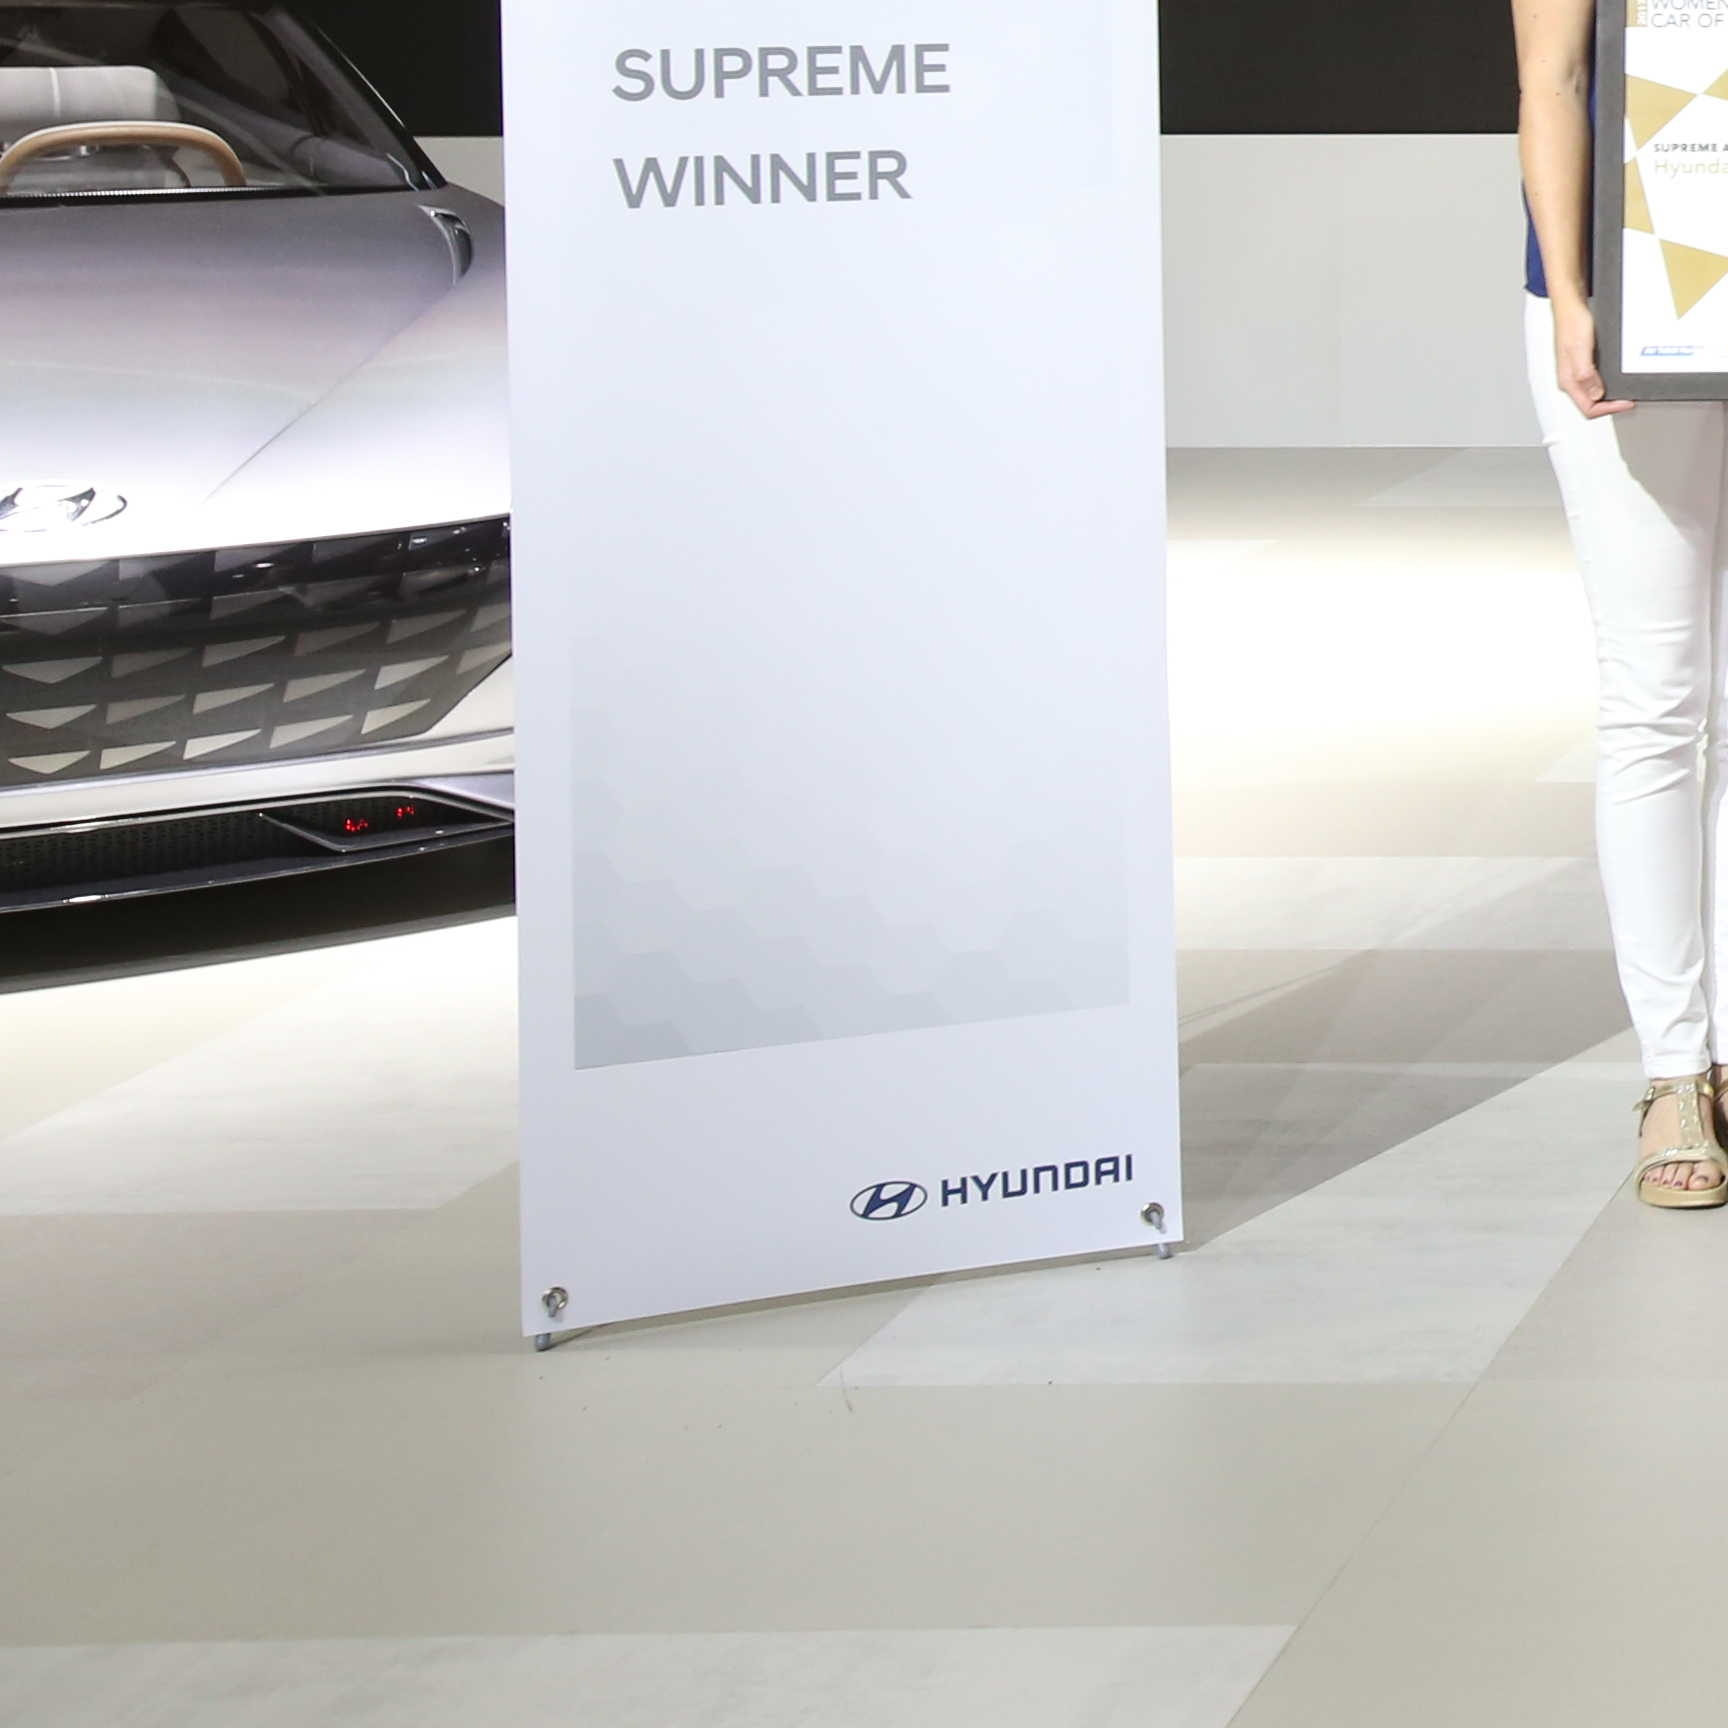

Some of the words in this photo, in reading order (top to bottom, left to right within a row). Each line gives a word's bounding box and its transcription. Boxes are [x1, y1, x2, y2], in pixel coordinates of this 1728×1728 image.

[1650, 13, 1690, 28] CAR
[1697, 13, 1725, 28] OF
[612, 43, 950, 102] SUPREME
[1653, 143, 1718, 153] SUPREME
[613, 150, 911, 209] WINNER
[941, 1154, 1134, 1208] HYUNDAI
